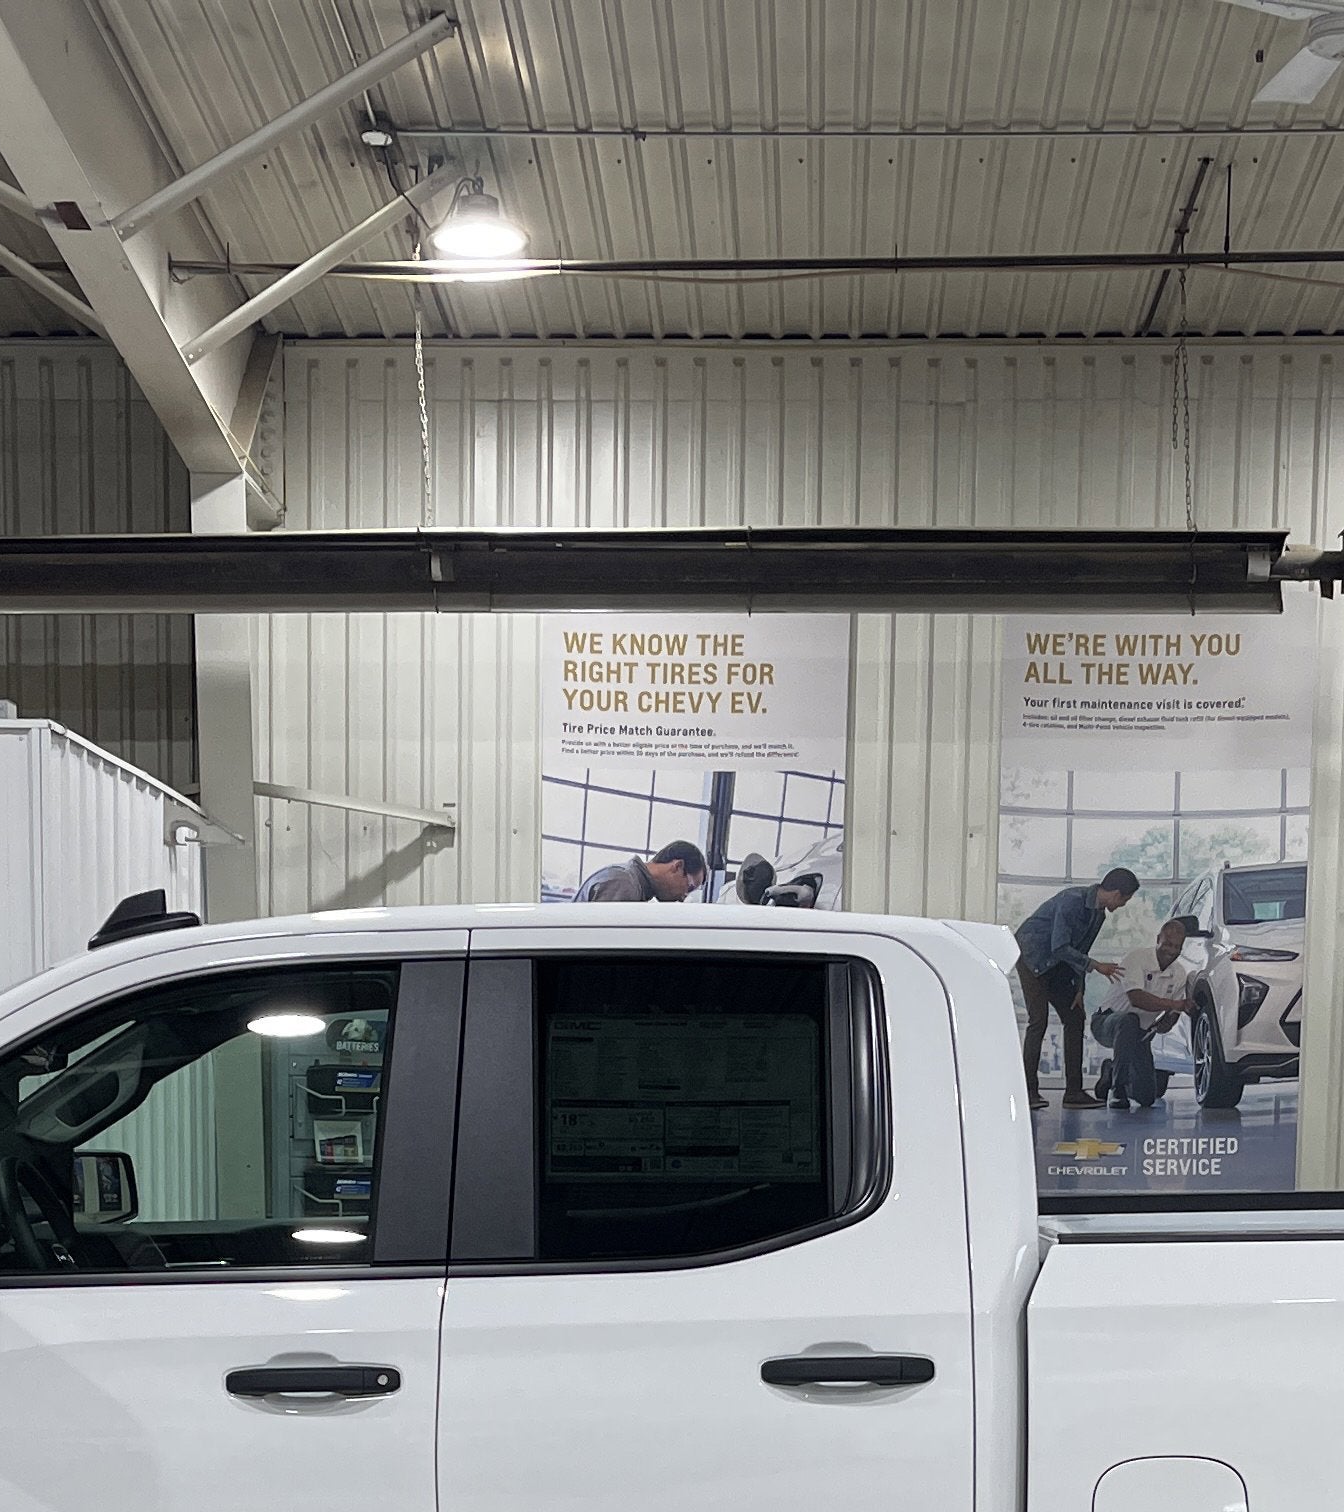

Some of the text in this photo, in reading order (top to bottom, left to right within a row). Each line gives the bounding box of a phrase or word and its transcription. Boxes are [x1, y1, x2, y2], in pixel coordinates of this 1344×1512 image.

[563, 632, 745, 657] WE KNOW THE
[1026, 632, 1241, 656] WE'RE WITH YOU
[563, 660, 775, 686] RIGHT TIRES FOR
[1024, 662, 1199, 686] ALL THE WAY.
[562, 689, 767, 714] YOUR CHEVY EV.
[1024, 697, 1049, 709] Your
[1052, 697, 1077, 709] first
[1080, 698, 1153, 710] maintenance
[1156, 698, 1181, 710] visit
[1184, 699, 1193, 710] is
[562, 723, 717, 737] Tire Price Match Guarantee.
[336, 1041, 379, 1052] BATTERIES
[1143, 1137, 1238, 1155] CERTIFIED
[1047, 1166, 1128, 1176] CHEVROLET
[1142, 1158, 1222, 1176] SERVICE
